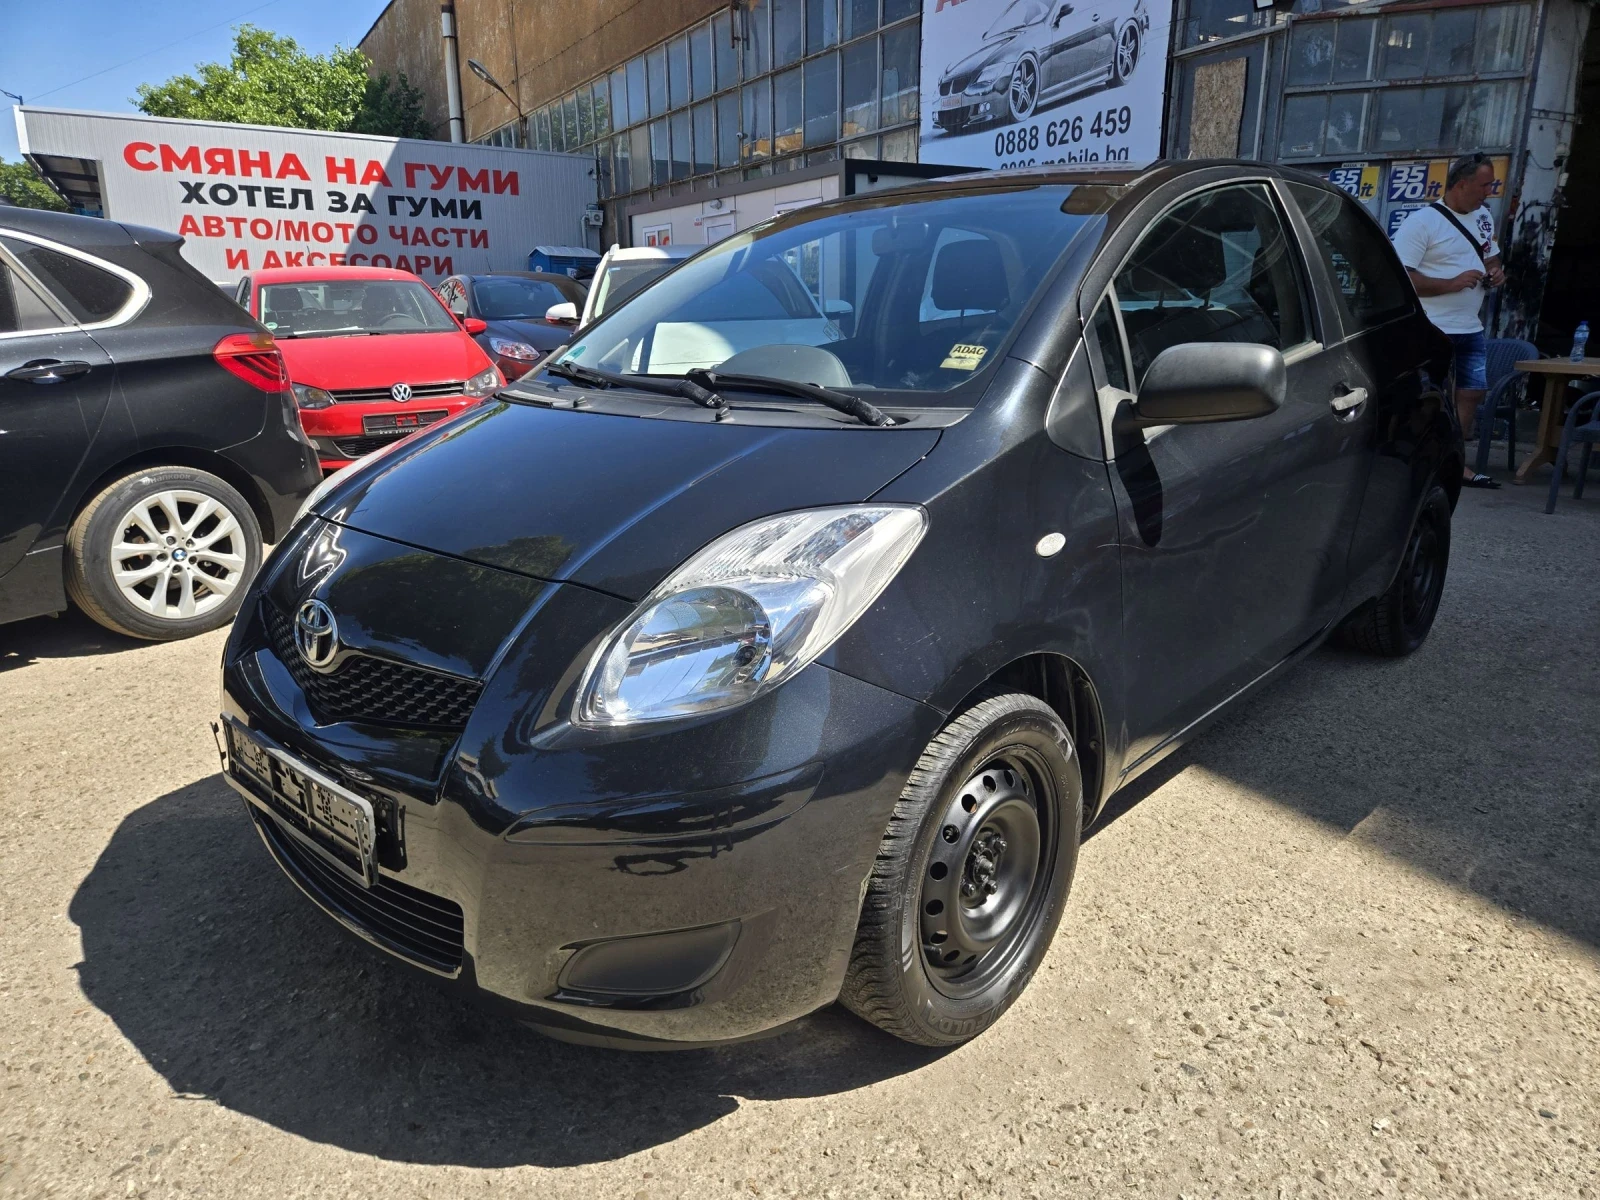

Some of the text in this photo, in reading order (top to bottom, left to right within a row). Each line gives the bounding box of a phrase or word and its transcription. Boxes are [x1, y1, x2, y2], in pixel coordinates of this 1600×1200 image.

[995, 125, 1039, 157] 0888
[1046, 116, 1083, 148] 626
[1090, 105, 1131, 138] 459
[123, 141, 519, 196] СМЯНА НА ГУМИ
[1333, 170, 1360, 184] 35
[1393, 166, 1427, 183] 35
[179, 181, 483, 220] ХОТЕЛ ЗА ГУМИ
[179, 215, 490, 249] АВТО/МОТО ЧАСТИ
[226, 248, 250, 271] И
[953, 346, 985, 355] ADAC
